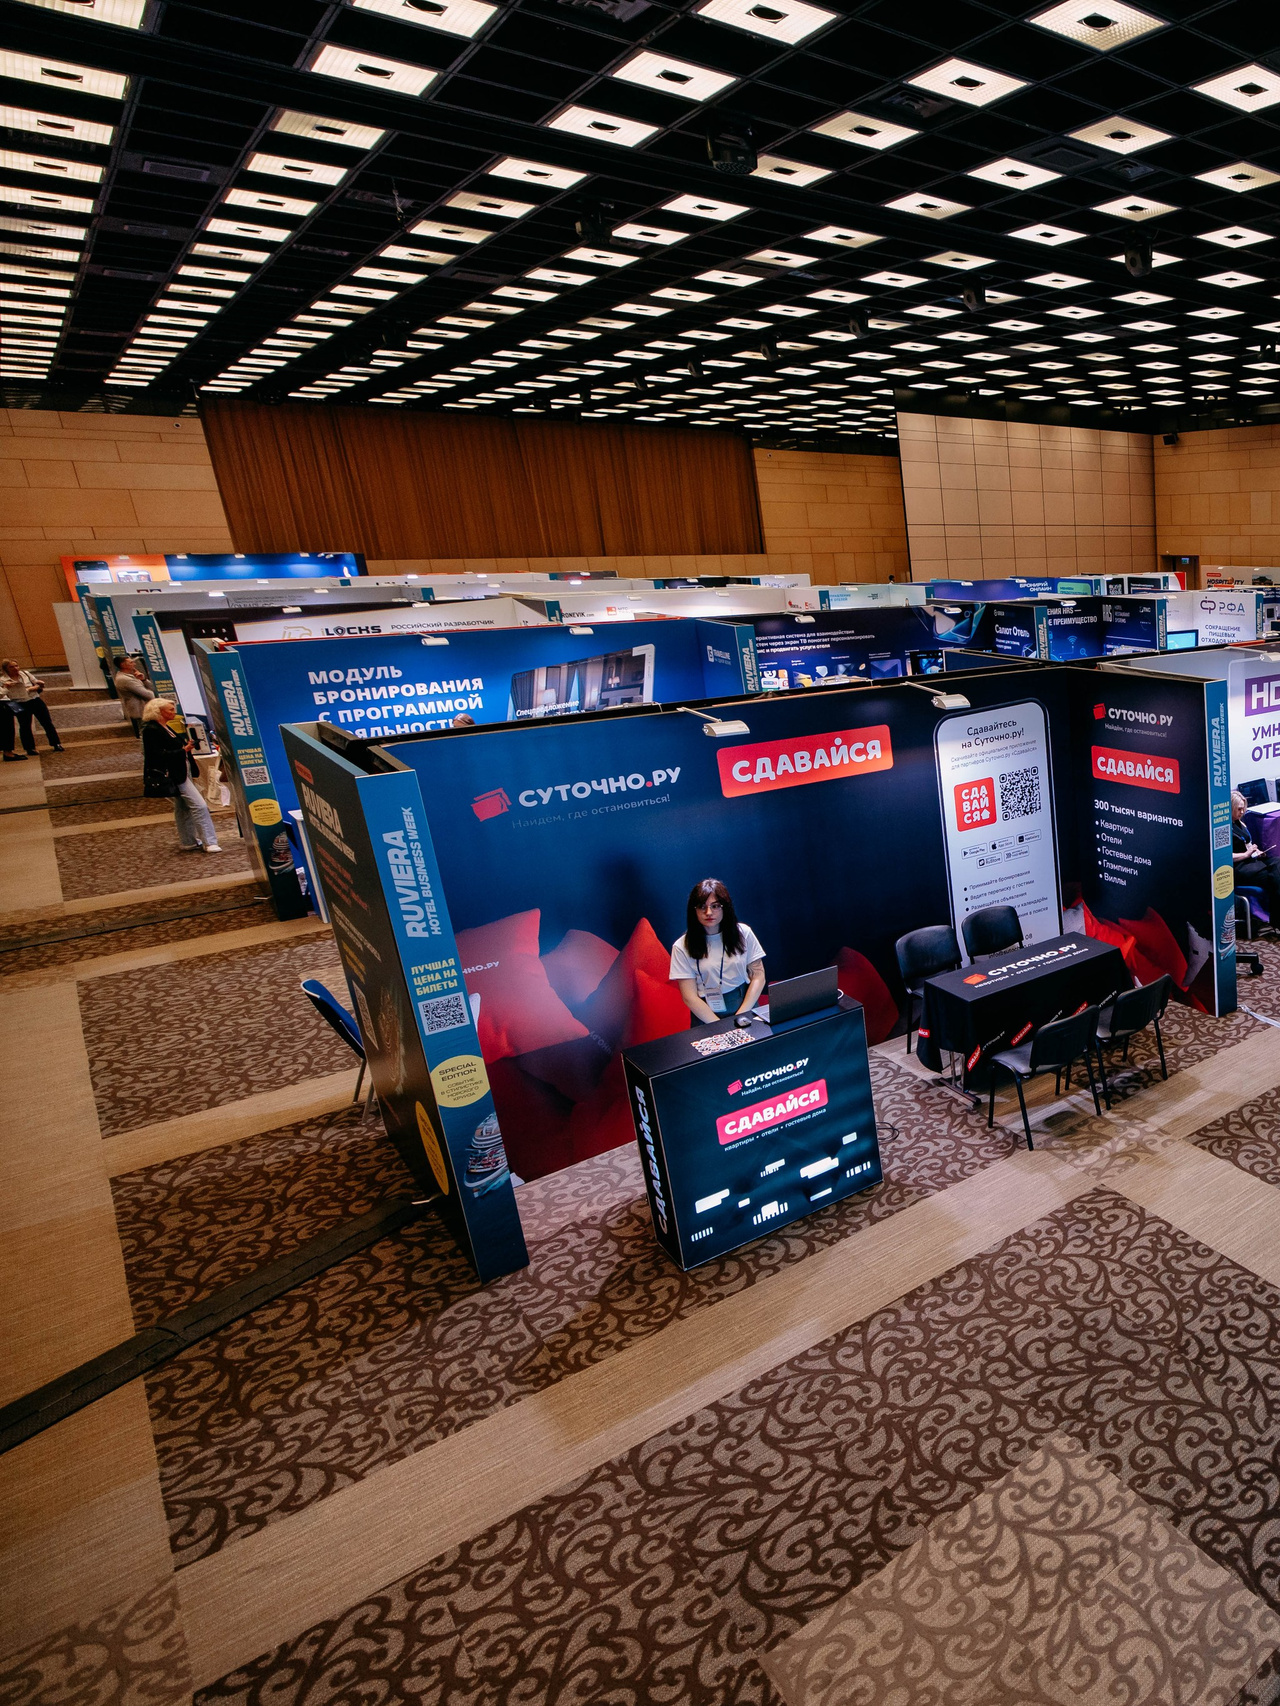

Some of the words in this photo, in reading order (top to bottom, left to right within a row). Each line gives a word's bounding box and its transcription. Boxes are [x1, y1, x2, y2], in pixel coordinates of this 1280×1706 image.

[391, 622, 442, 630] РОССИЙСКИЙ
[1053, 616, 1098, 626] ПРЕИМУЩЕСТВО
[308, 665, 402, 685] МОДУЛЬ
[742, 648, 755, 691] RUVIERA
[313, 678, 484, 705] БРОНИРОВАНИЯ
[221, 680, 248, 736] RUVIERA
[338, 694, 483, 724] ПРОГРАММОЙ
[1108, 707, 1174, 727] СУТОЧНО.РУ
[967, 719, 1017, 737] Сдавайтесь
[961, 742, 972, 750] на
[974, 728, 1025, 747] Суточно.ру!
[732, 738, 882, 784] СДАВАЙСЯ
[1211, 717, 1223, 787] RUVIERA
[1097, 757, 1174, 784] СДАВАЙСЯ
[518, 766, 682, 808] СУТОЧНО.РУ
[962, 785, 988, 800] СДА
[301, 782, 344, 839] RUVIERA
[568, 809, 589, 822] где
[591, 794, 671, 816] остановиться!
[962, 794, 990, 813] ВАЙ
[1094, 799, 1109, 811] 300
[1111, 805, 1136, 817] тысяч
[1137, 811, 1184, 827] вариантов
[401, 807, 419, 840] WEEK
[964, 812, 981, 824] СЯ
[1100, 819, 1135, 835] Квартиры
[1101, 833, 1122, 845] Отели
[1102, 846, 1133, 861] Гостевые
[1134, 855, 1152, 866] дома
[412, 842, 434, 898] BUSINESS
[1103, 860, 1139, 877] Глэмпинги
[382, 830, 430, 938] RUVIERA
[969, 879, 998, 890] Принимайте
[998, 870, 1031, 882] бронирования
[1104, 873, 1127, 886] Виллы
[426, 900, 442, 935] HOTEL
[411, 958, 456, 976] ЛУЧШАЯ
[988, 944, 1078, 976] СУТОЧНО.РУ
[413, 972, 442, 986] ЦЕНА
[443, 969, 458, 979] НА
[974, 975, 1010, 989] квартиры
[416, 980, 458, 997] БИЛЕТЫ
[439, 1062, 477, 1076] SPECIAL
[441, 1068, 477, 1082] EDITION
[744, 1058, 809, 1087] СУТОЧНО.РУ
[772, 1070, 804, 1085] остановиться!
[724, 1089, 820, 1135] СДАВАЙСЯ
[725, 1137, 755, 1152] квартиры
[761, 1127, 779, 1138] отели
[785, 1114, 812, 1128] гостевые
[812, 1108, 827, 1118] дома
[635, 1086, 669, 1236] СДАВАЙСЯ
